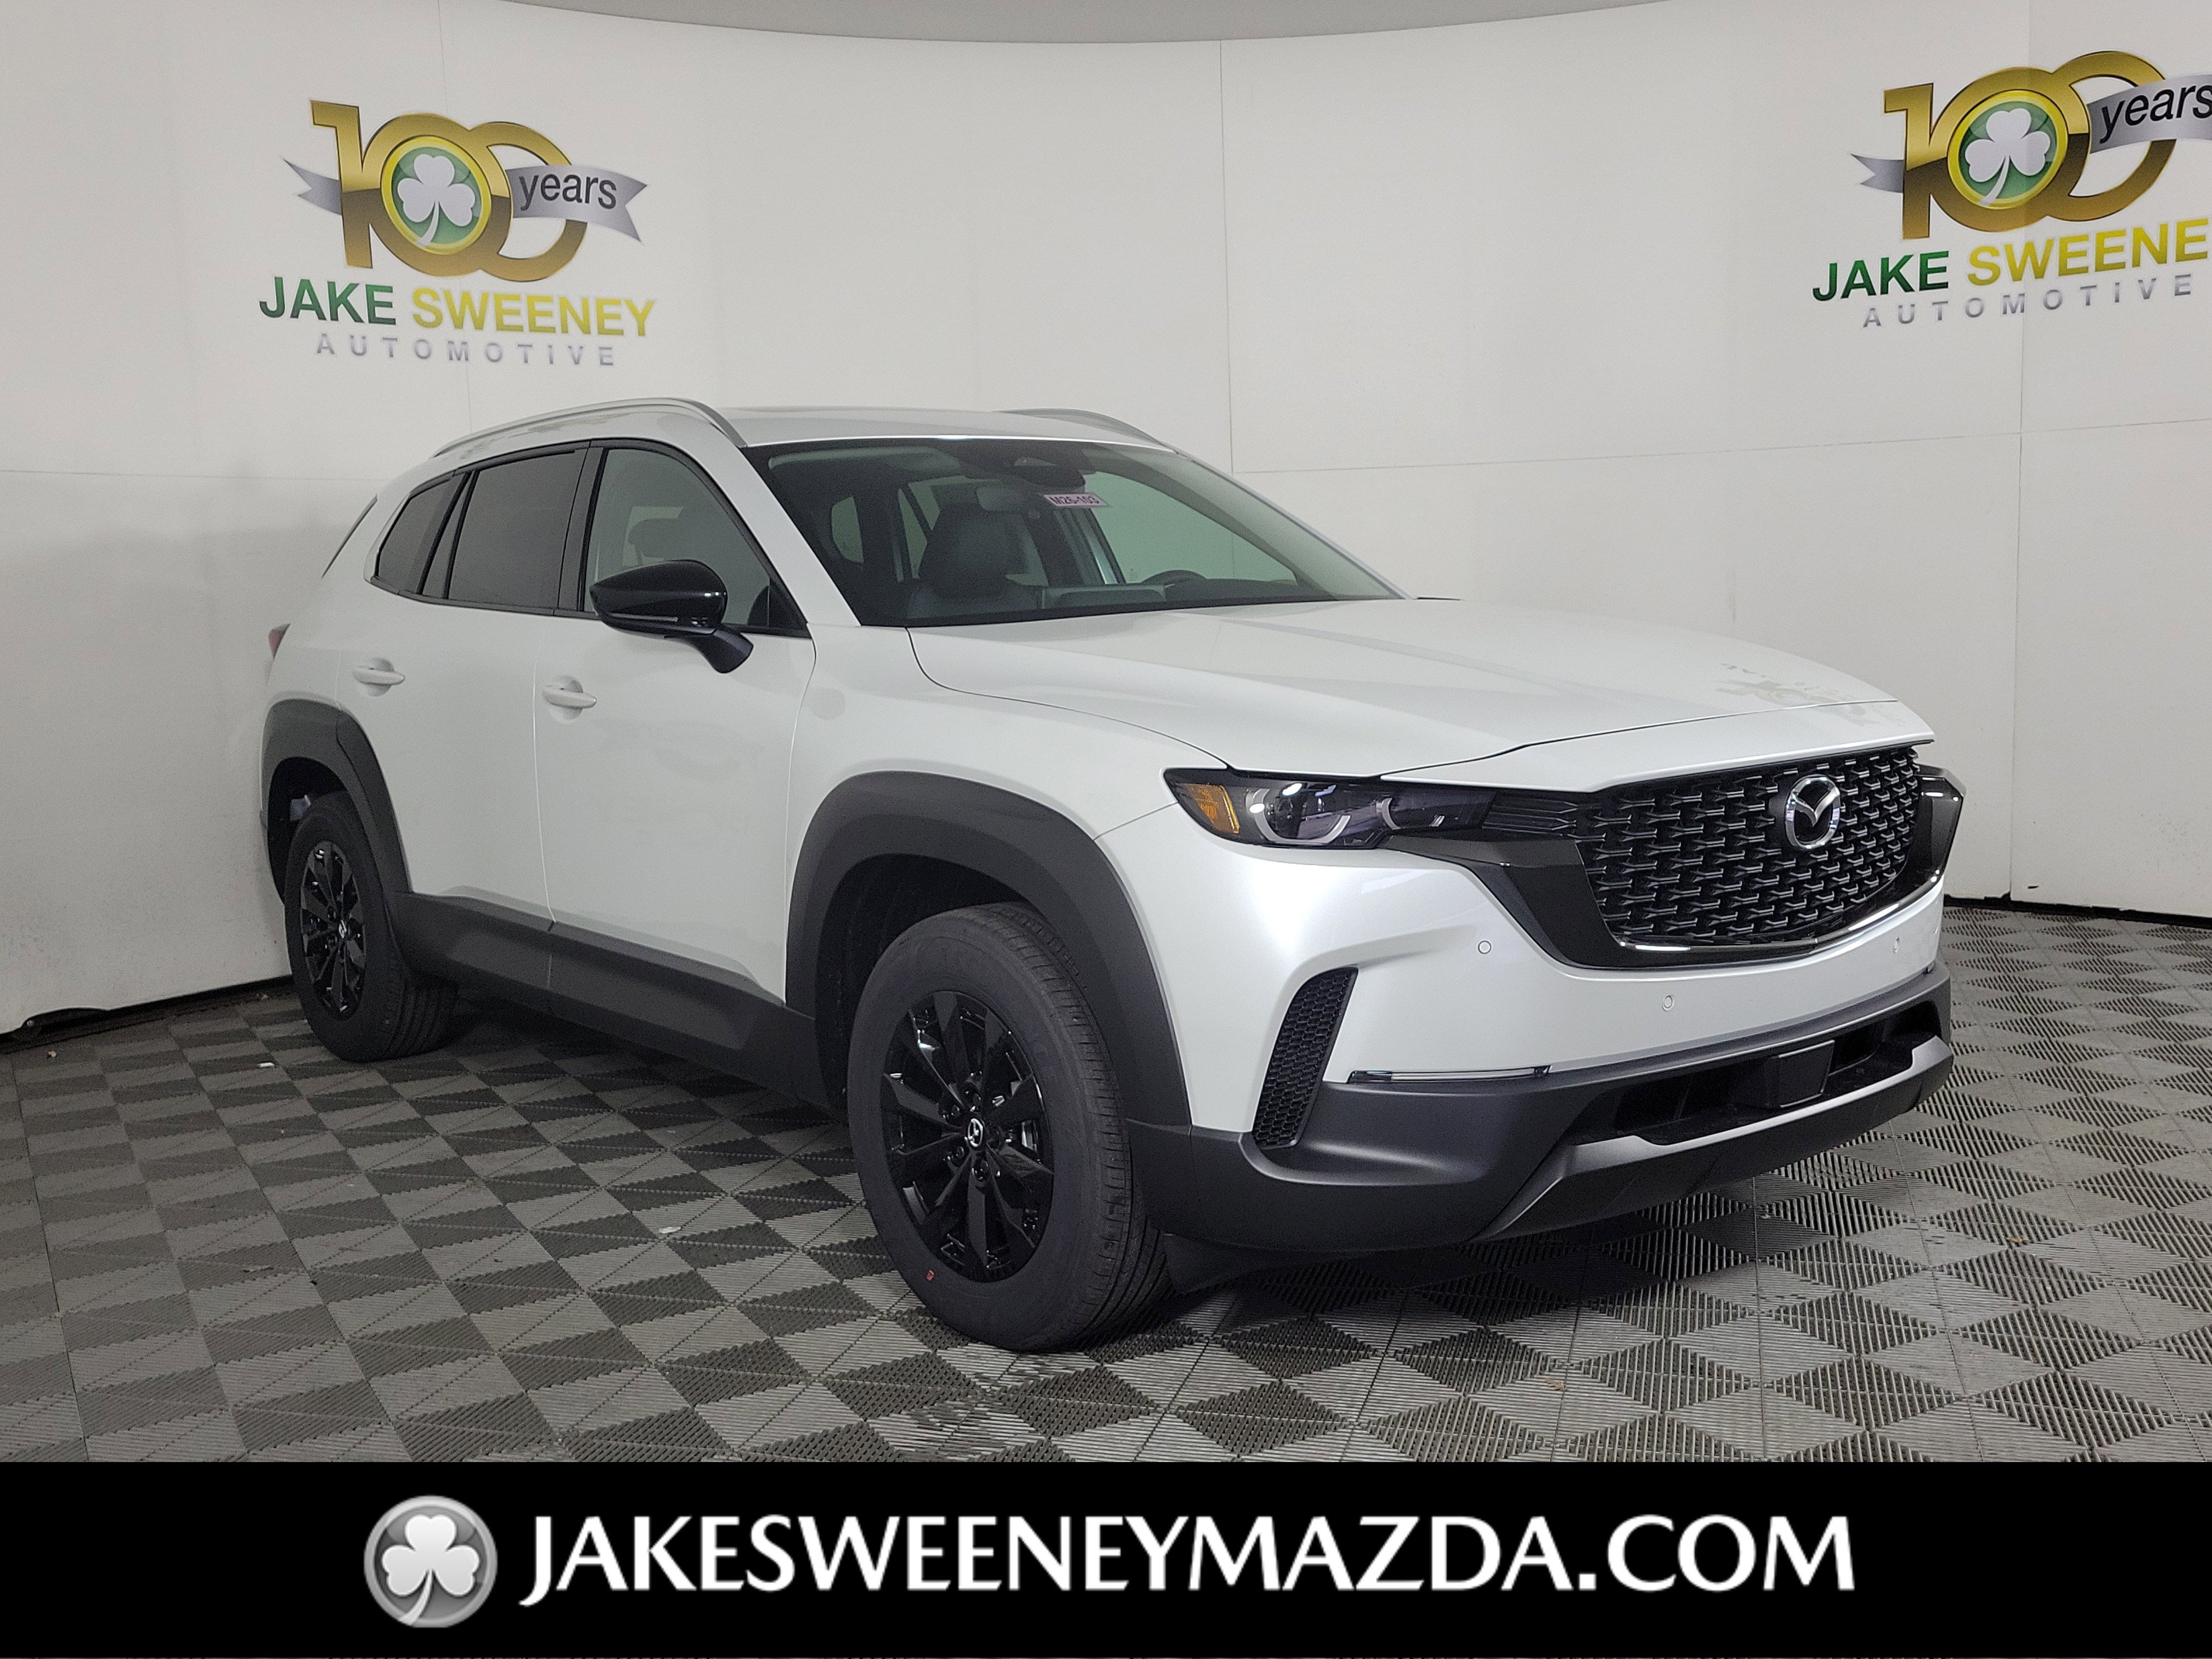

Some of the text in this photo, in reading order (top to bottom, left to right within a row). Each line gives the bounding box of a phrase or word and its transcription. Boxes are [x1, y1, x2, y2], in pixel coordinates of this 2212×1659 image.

[2099, 85, 2212, 144] years
[518, 172, 617, 211] years
[1812, 251, 1949, 301] JAKE
[1863, 274, 2191, 328] AUTOMOTIVE
[259, 276, 655, 336] JAKE SWEENEY
[317, 333, 613, 366] AUTOMOTIVE
